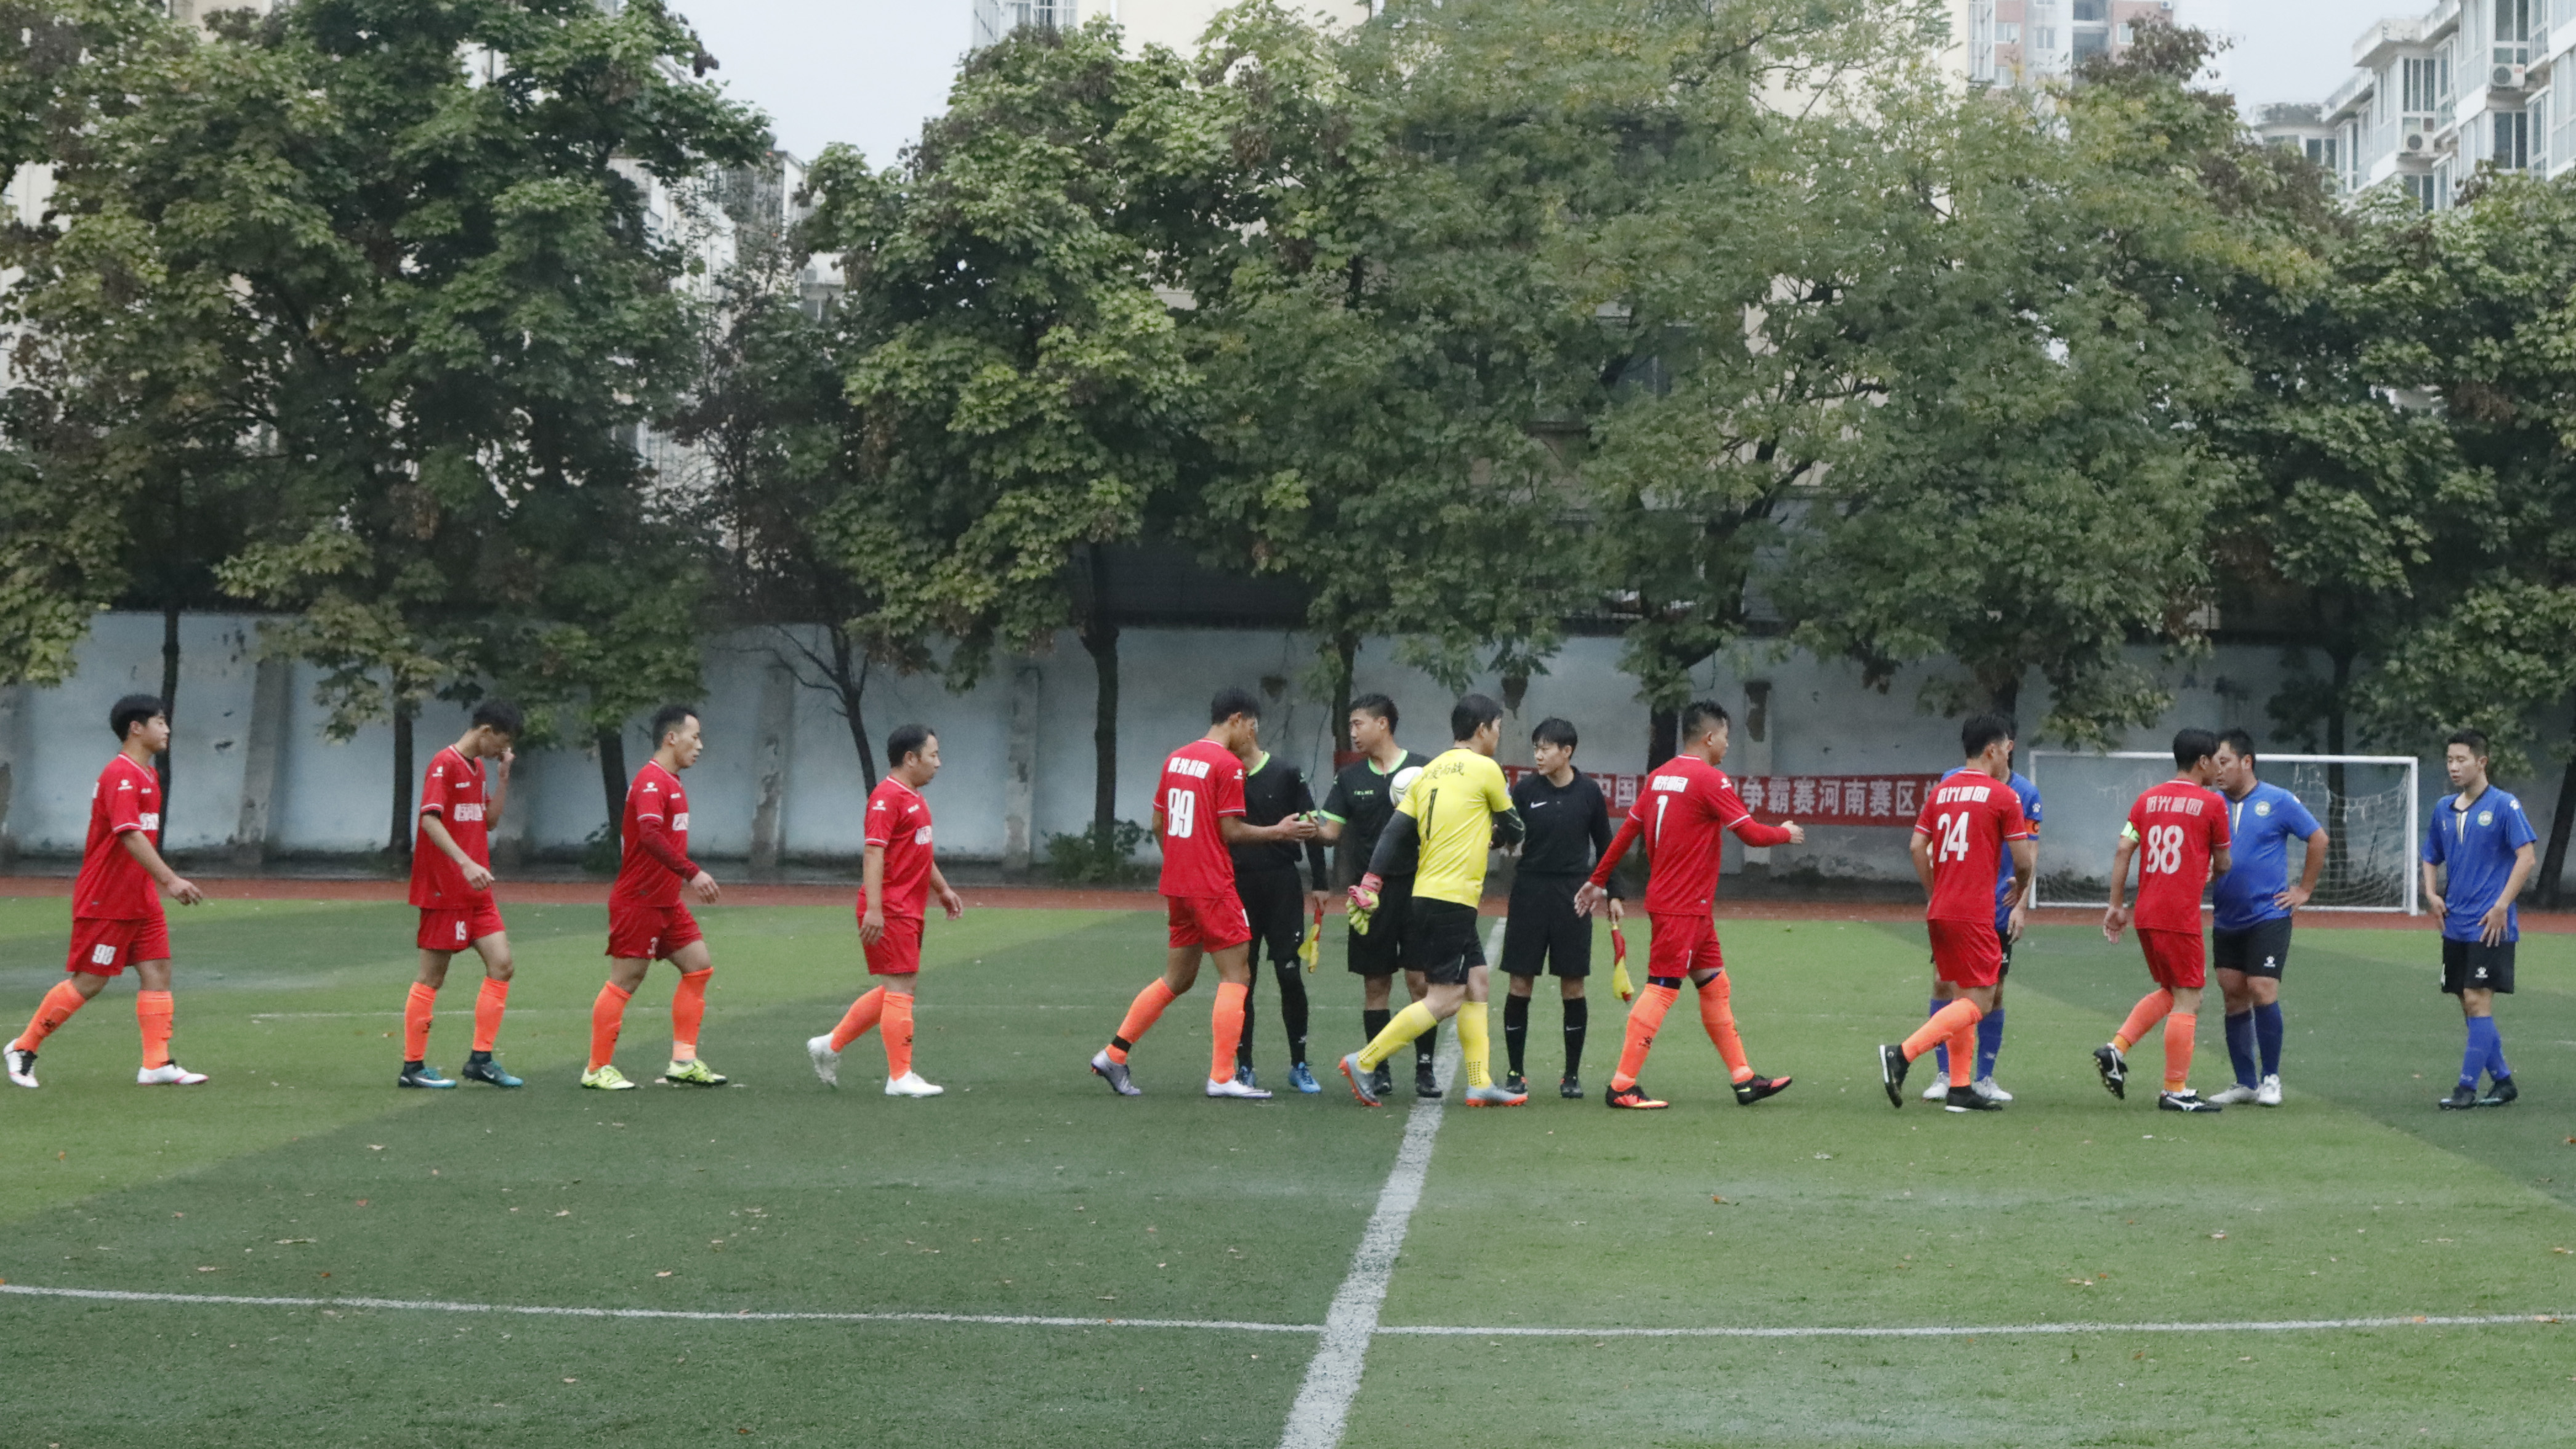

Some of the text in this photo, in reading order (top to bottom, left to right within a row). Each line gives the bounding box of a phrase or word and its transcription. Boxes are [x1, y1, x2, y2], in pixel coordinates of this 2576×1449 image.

[1168, 788, 1195, 838] 89
[1734, 776, 1938, 817] 争霸赛河南赛区
[1937, 811, 1970, 863] 24
[2146, 825, 2184, 874] 88
